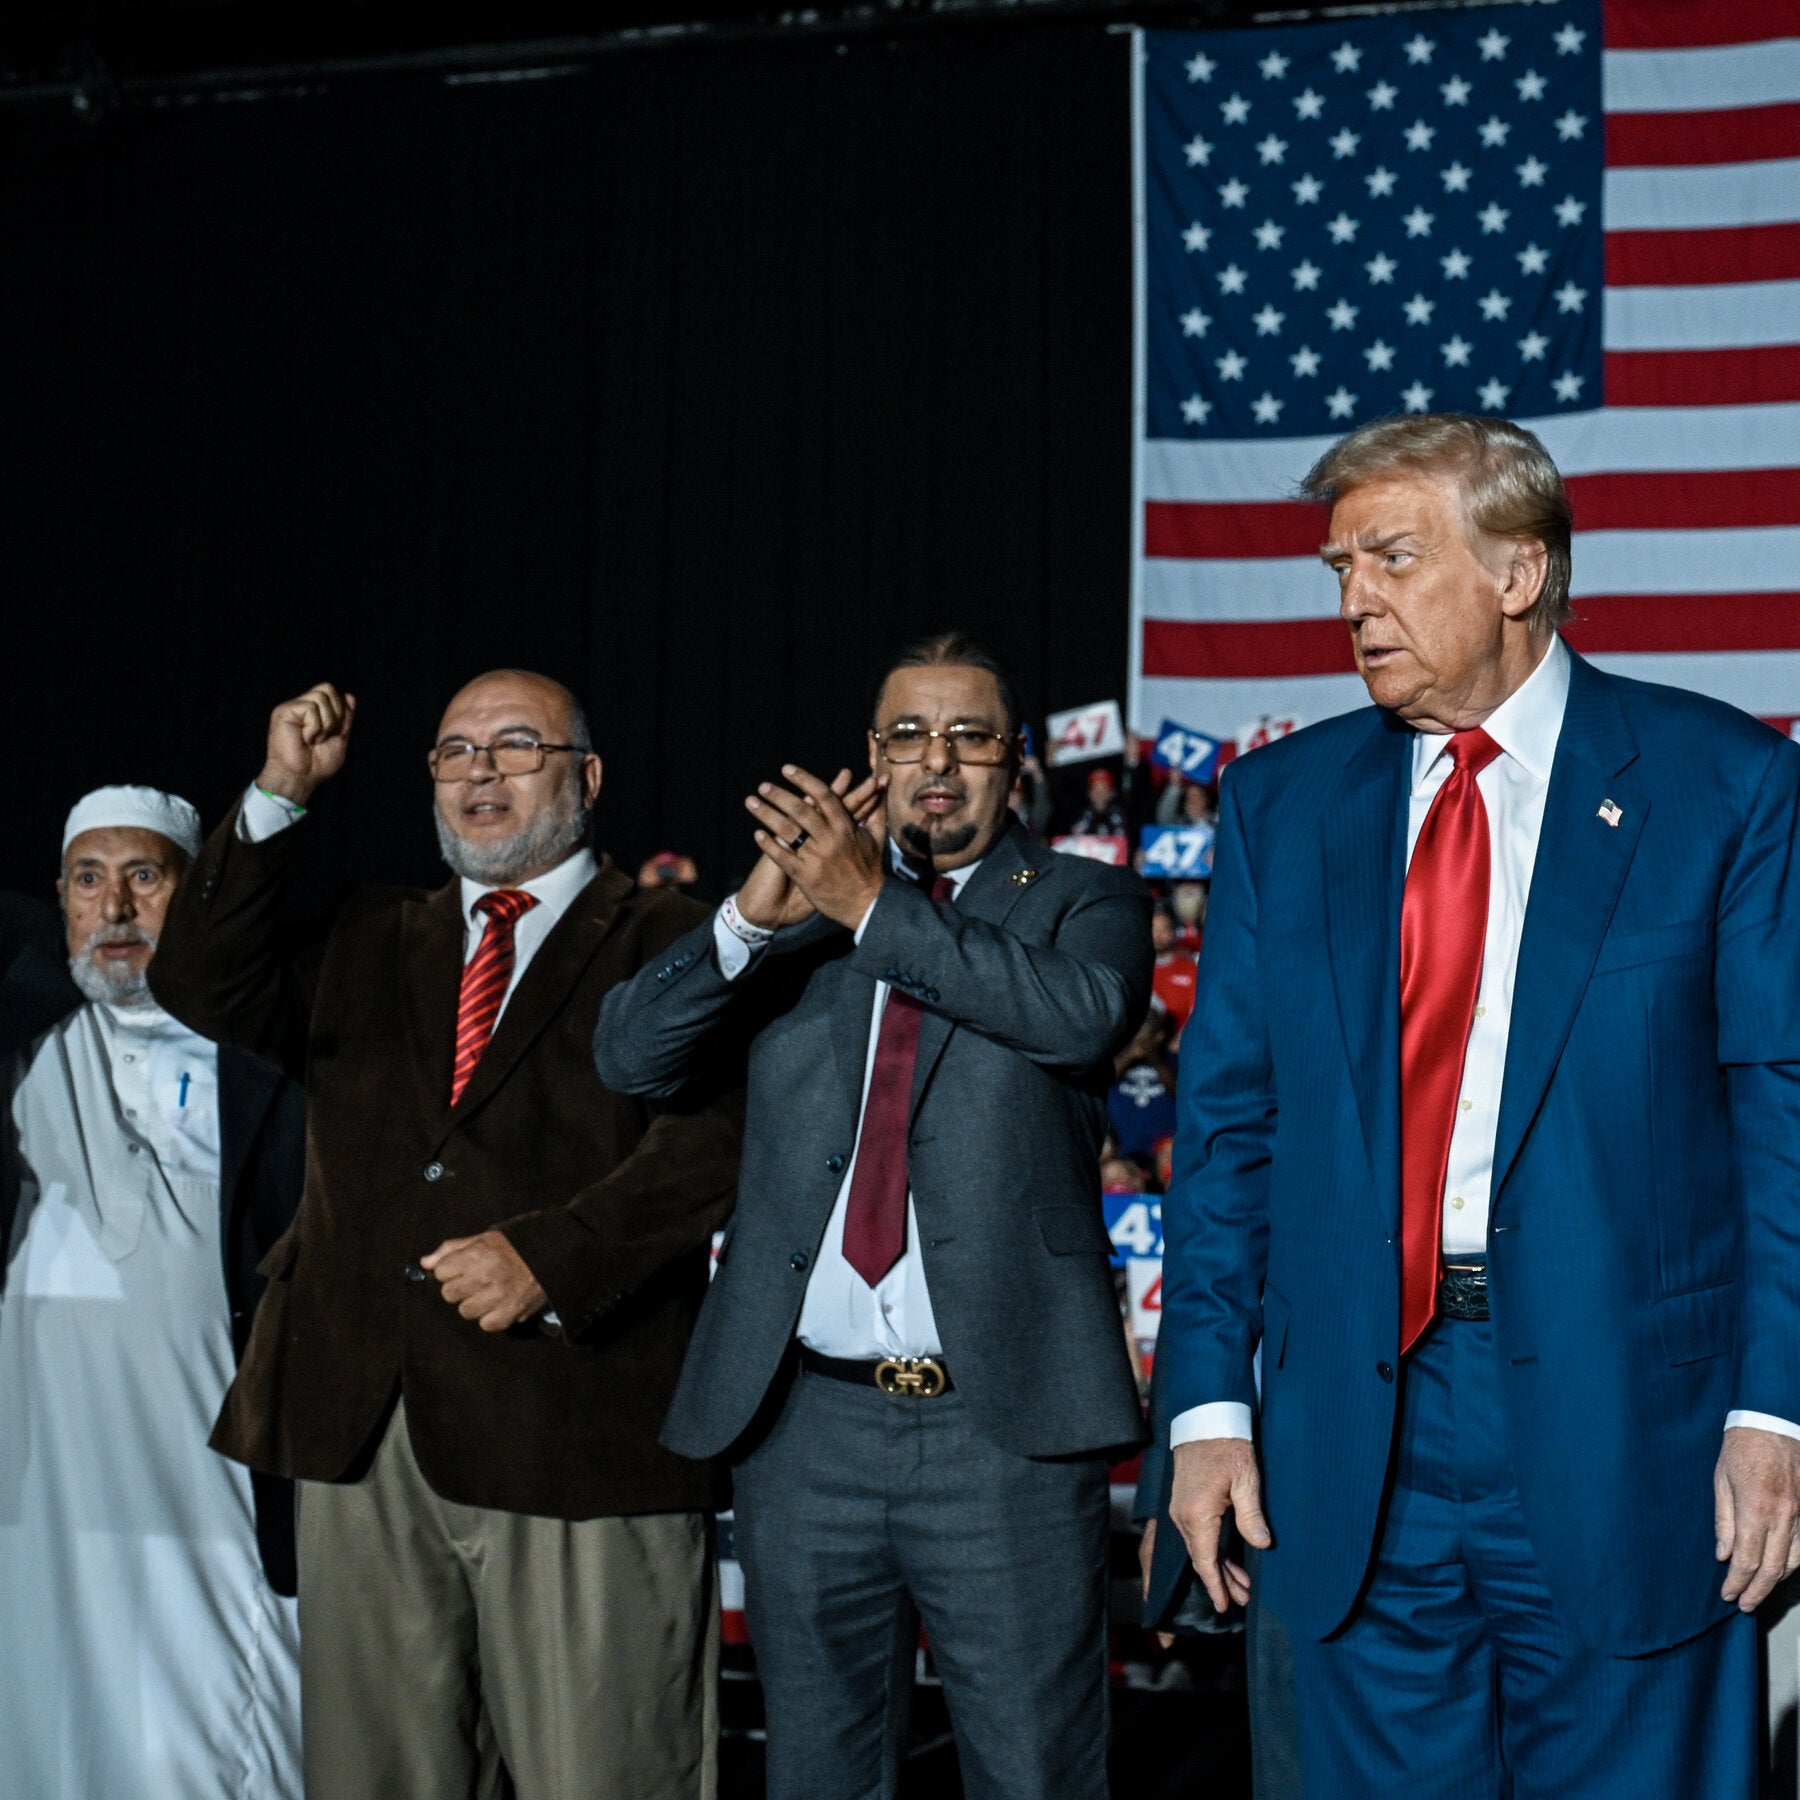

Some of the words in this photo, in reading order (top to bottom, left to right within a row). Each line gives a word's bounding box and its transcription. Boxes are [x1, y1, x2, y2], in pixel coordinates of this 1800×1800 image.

[1062, 713, 1107, 748] 47
[1156, 730, 1214, 772] 47
[1144, 831, 1208, 869] 47
